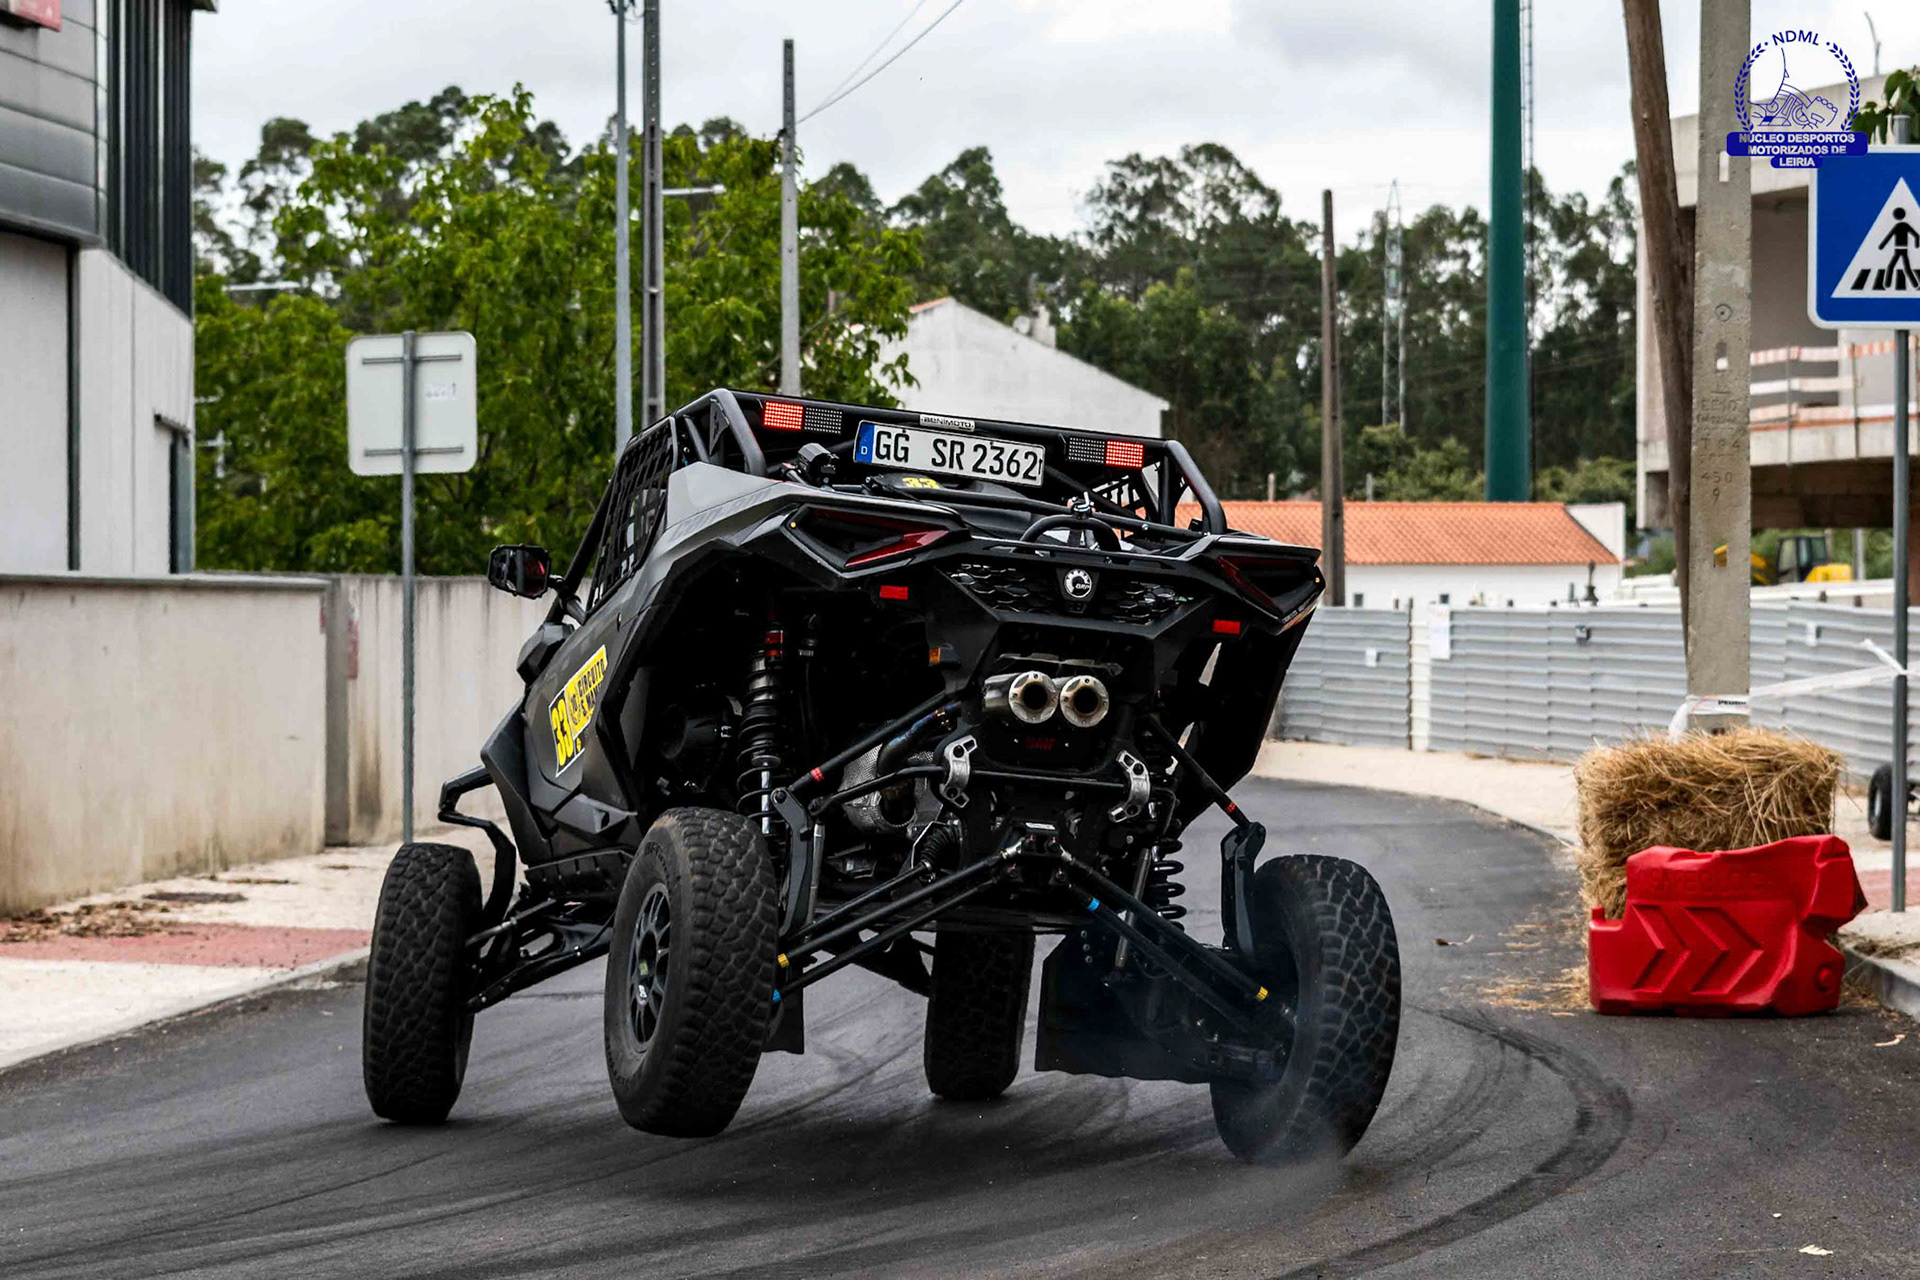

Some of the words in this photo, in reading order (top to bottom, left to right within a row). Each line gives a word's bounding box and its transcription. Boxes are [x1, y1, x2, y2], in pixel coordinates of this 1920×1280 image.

[860, 445, 867, 455] D
[875, 431, 910, 462] GG
[931, 438, 965, 470] SR
[972, 443, 1038, 480] 2362
[902, 477, 940, 489] 33
[551, 698, 574, 767] 33
